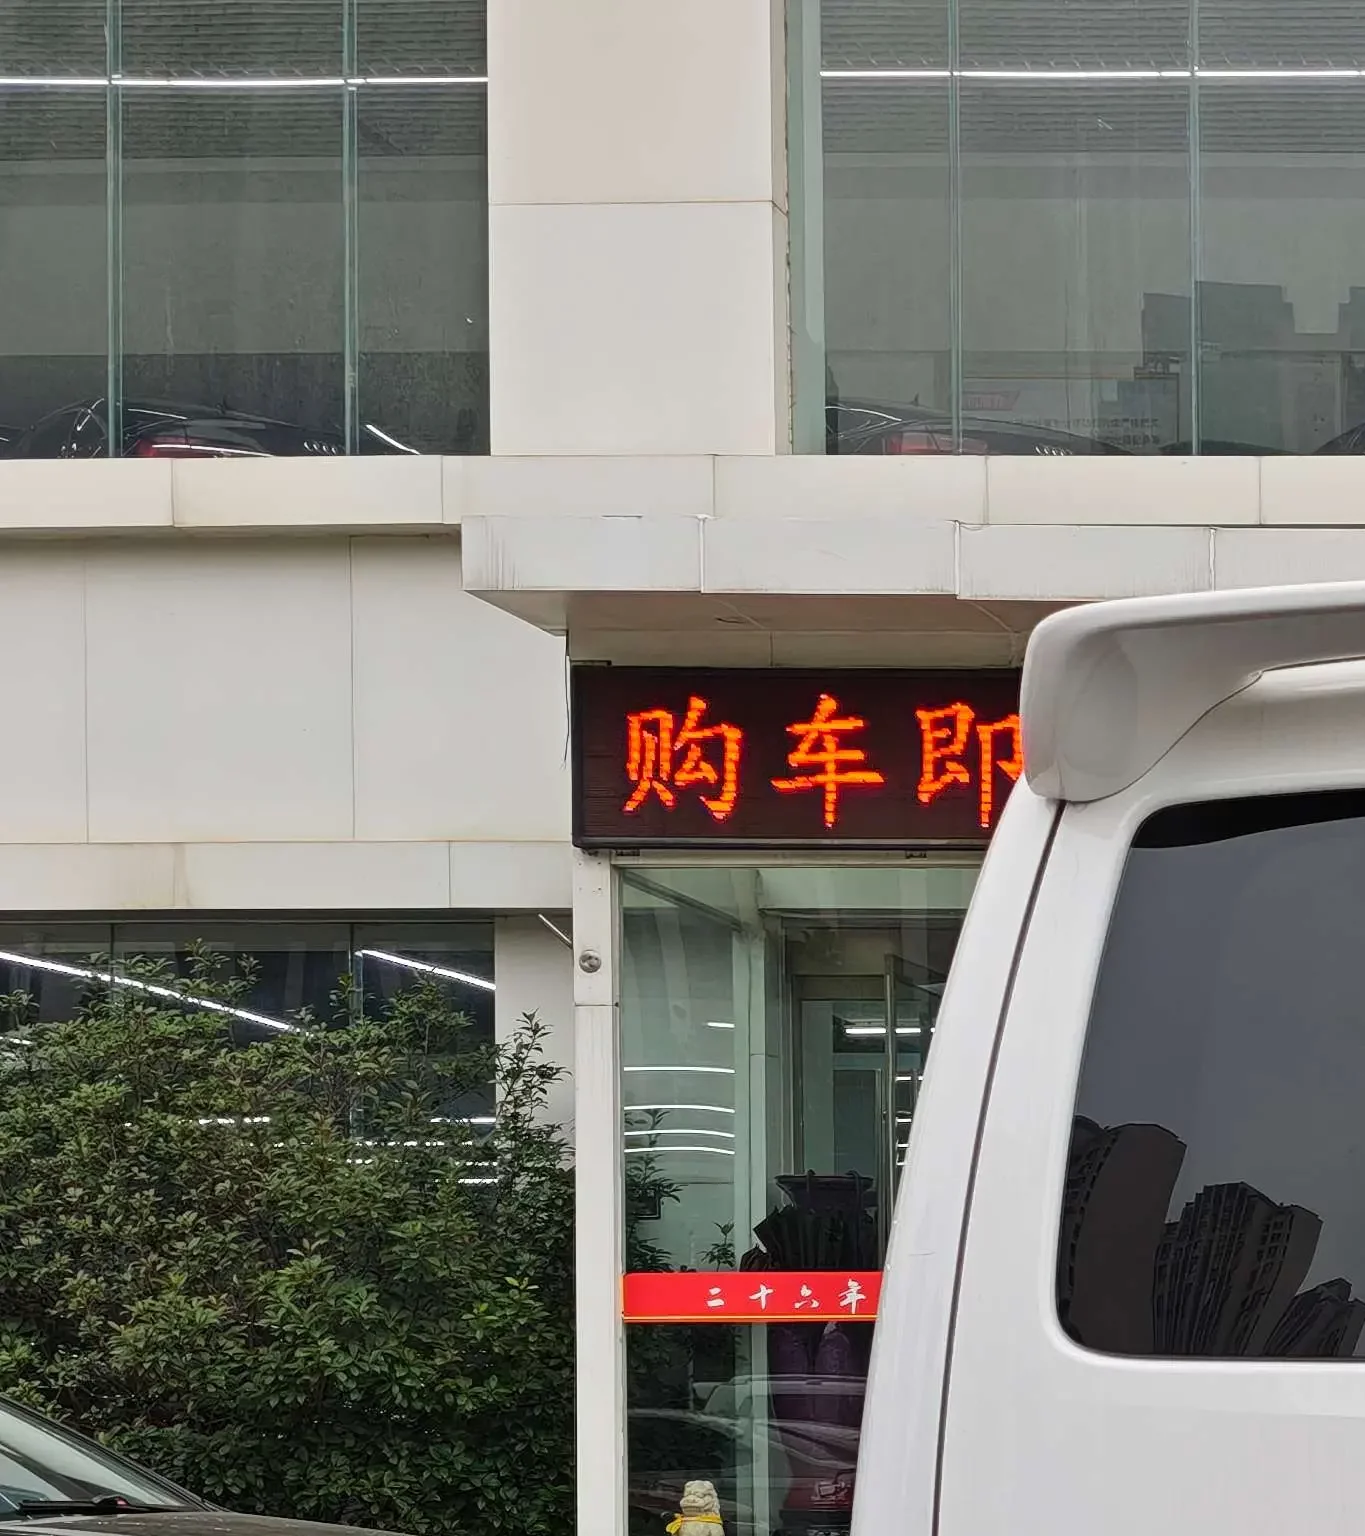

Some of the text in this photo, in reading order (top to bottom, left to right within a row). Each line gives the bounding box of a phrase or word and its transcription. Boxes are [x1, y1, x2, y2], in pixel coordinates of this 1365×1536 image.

[623, 694, 1024, 829] 购车即
[706, 1278, 867, 1315] 二十六年
